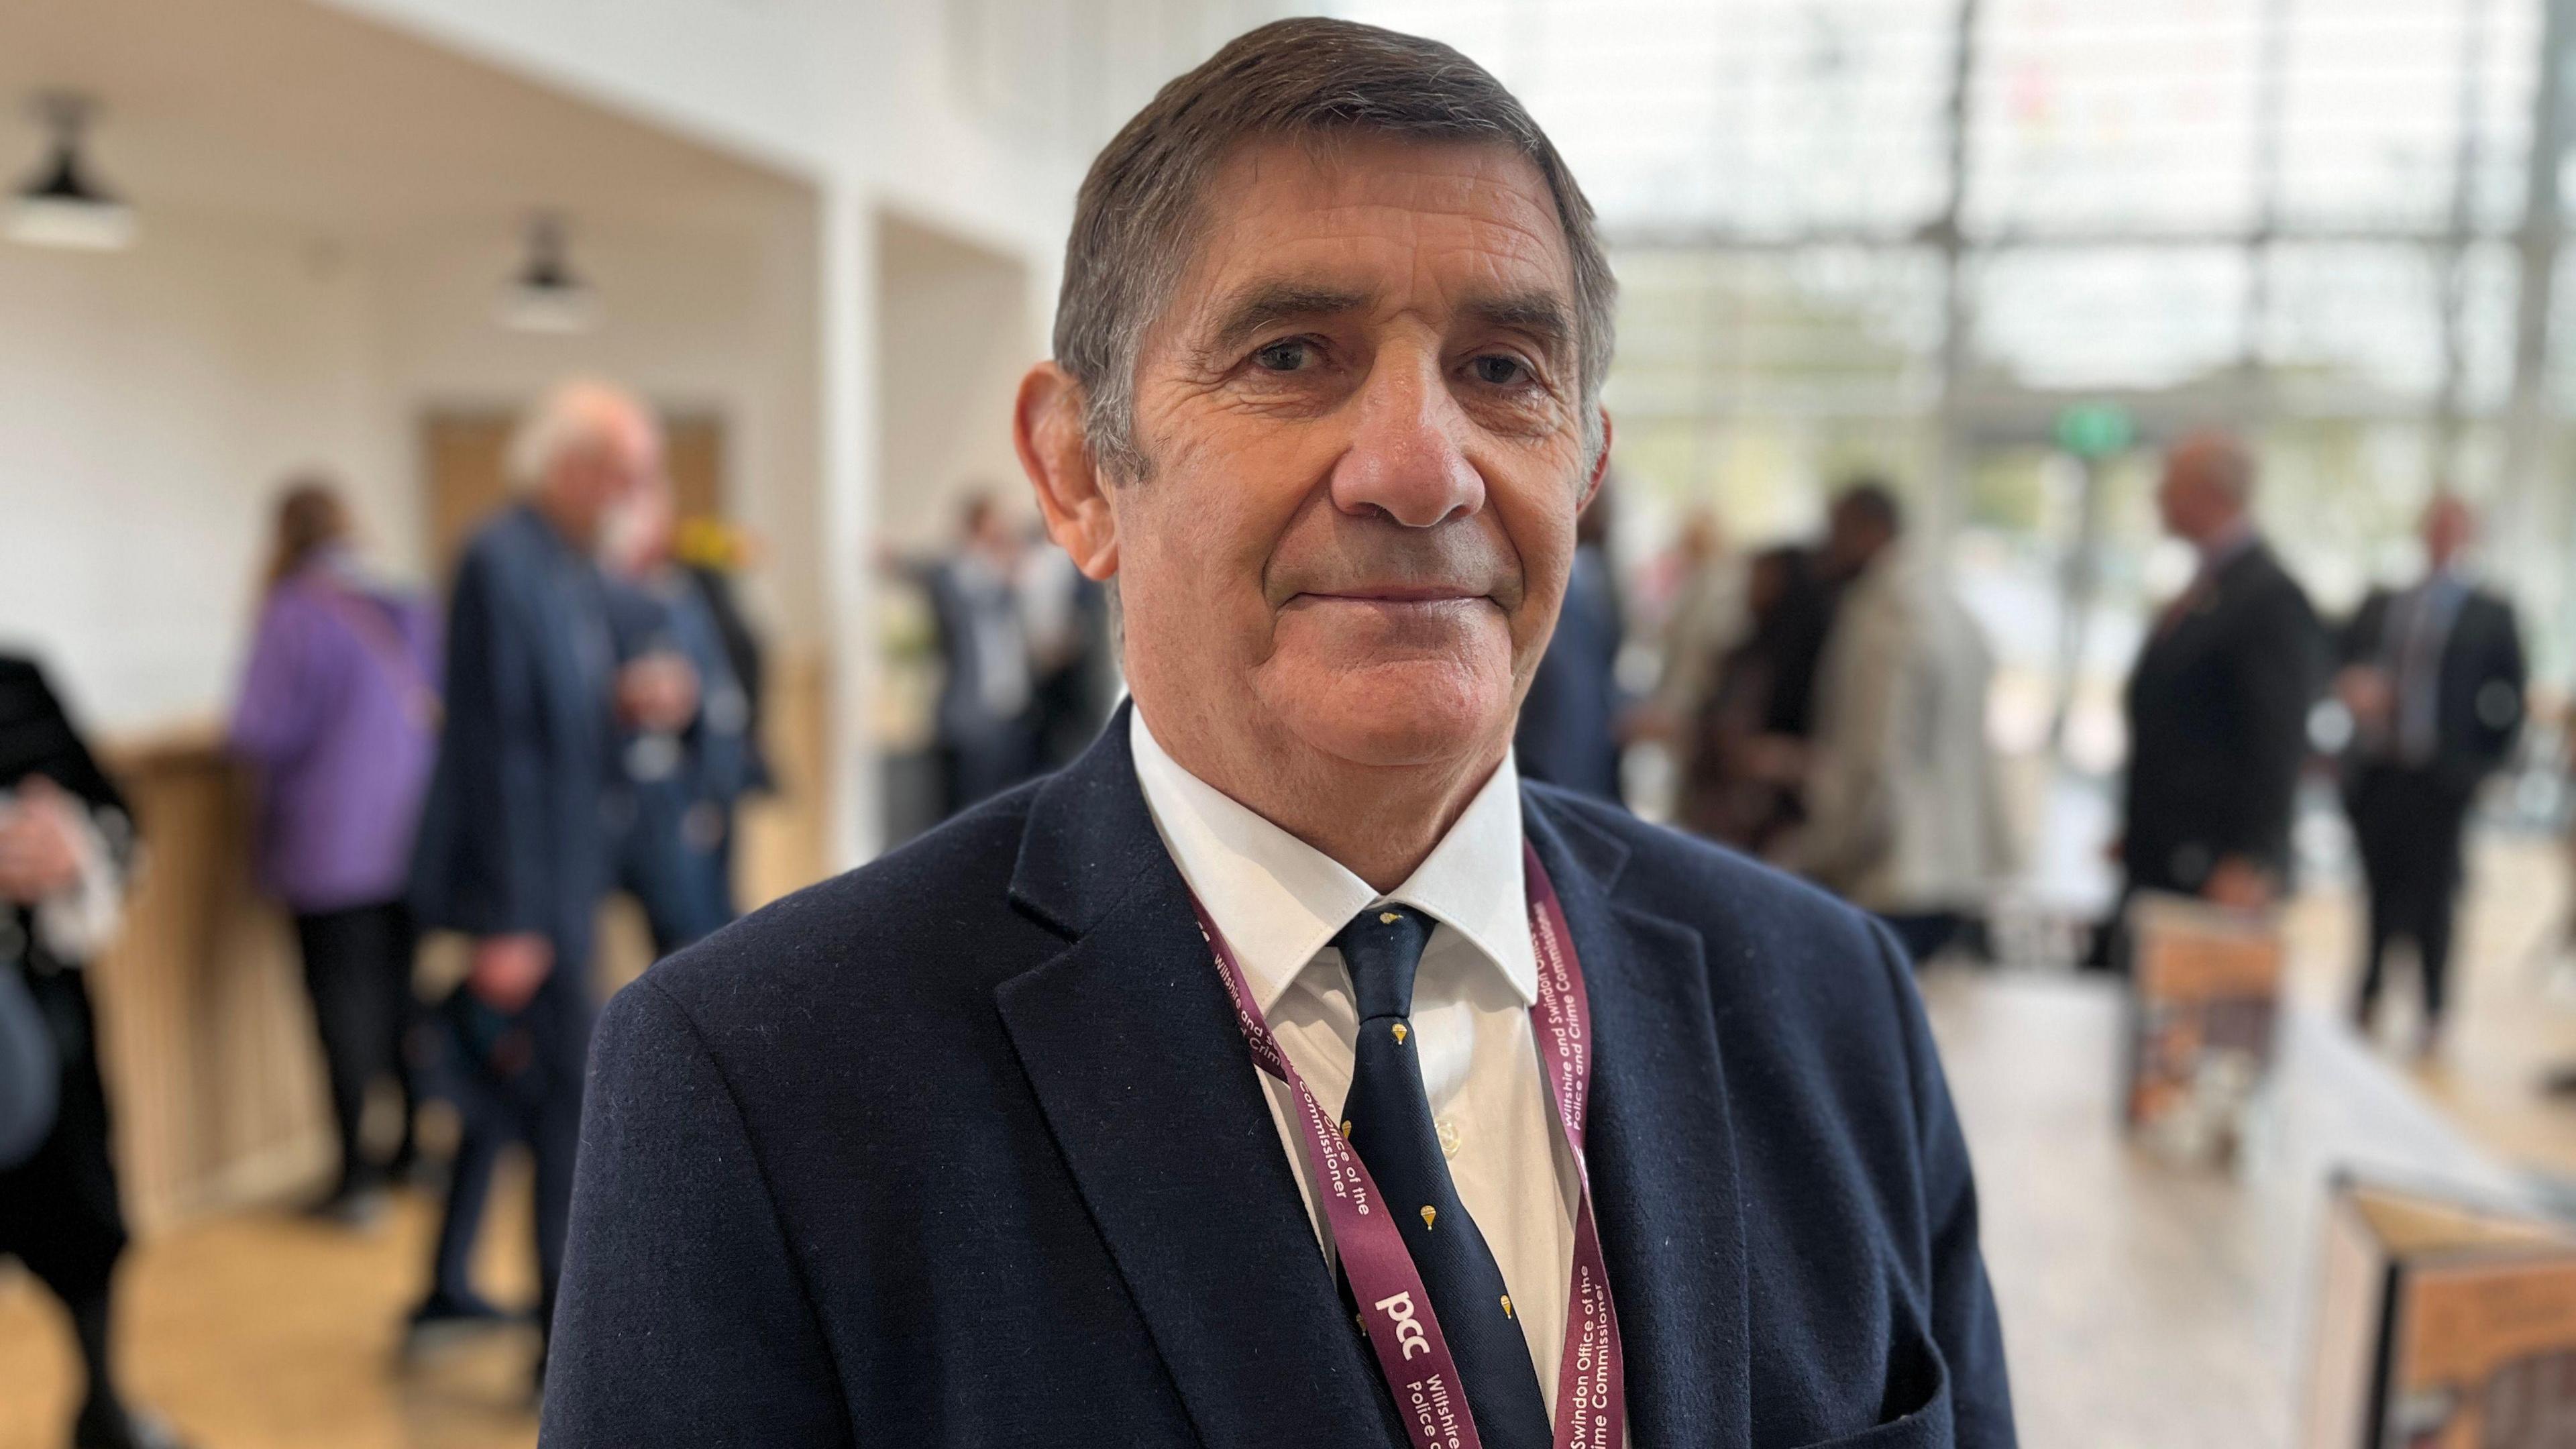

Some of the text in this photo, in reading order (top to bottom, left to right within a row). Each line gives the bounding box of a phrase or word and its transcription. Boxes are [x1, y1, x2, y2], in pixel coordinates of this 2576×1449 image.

[1215, 953, 1263, 1037] Wiltshire and
[1538, 972, 1563, 1024] Swindon
[1564, 995, 1580, 1039] Crime
[1551, 1028, 1570, 1057] and
[1571, 1044, 1583, 1076] and
[1249, 1037, 1348, 1199] Crim Commissioner
[1562, 1061, 1572, 1126] Wiltshire
[1573, 1081, 1582, 1130] Police
[1347, 1167, 1361, 1185] of
[1352, 1187, 1369, 1216] the
[1375, 1291, 1430, 1362] pcc
[1570, 1265, 1594, 1449] Swindon Office of the
[1591, 1284, 1608, 1449] ime Commissioner
[1406, 1381, 1436, 1437] Police
[1426, 1373, 1460, 1449] Wiltshire
